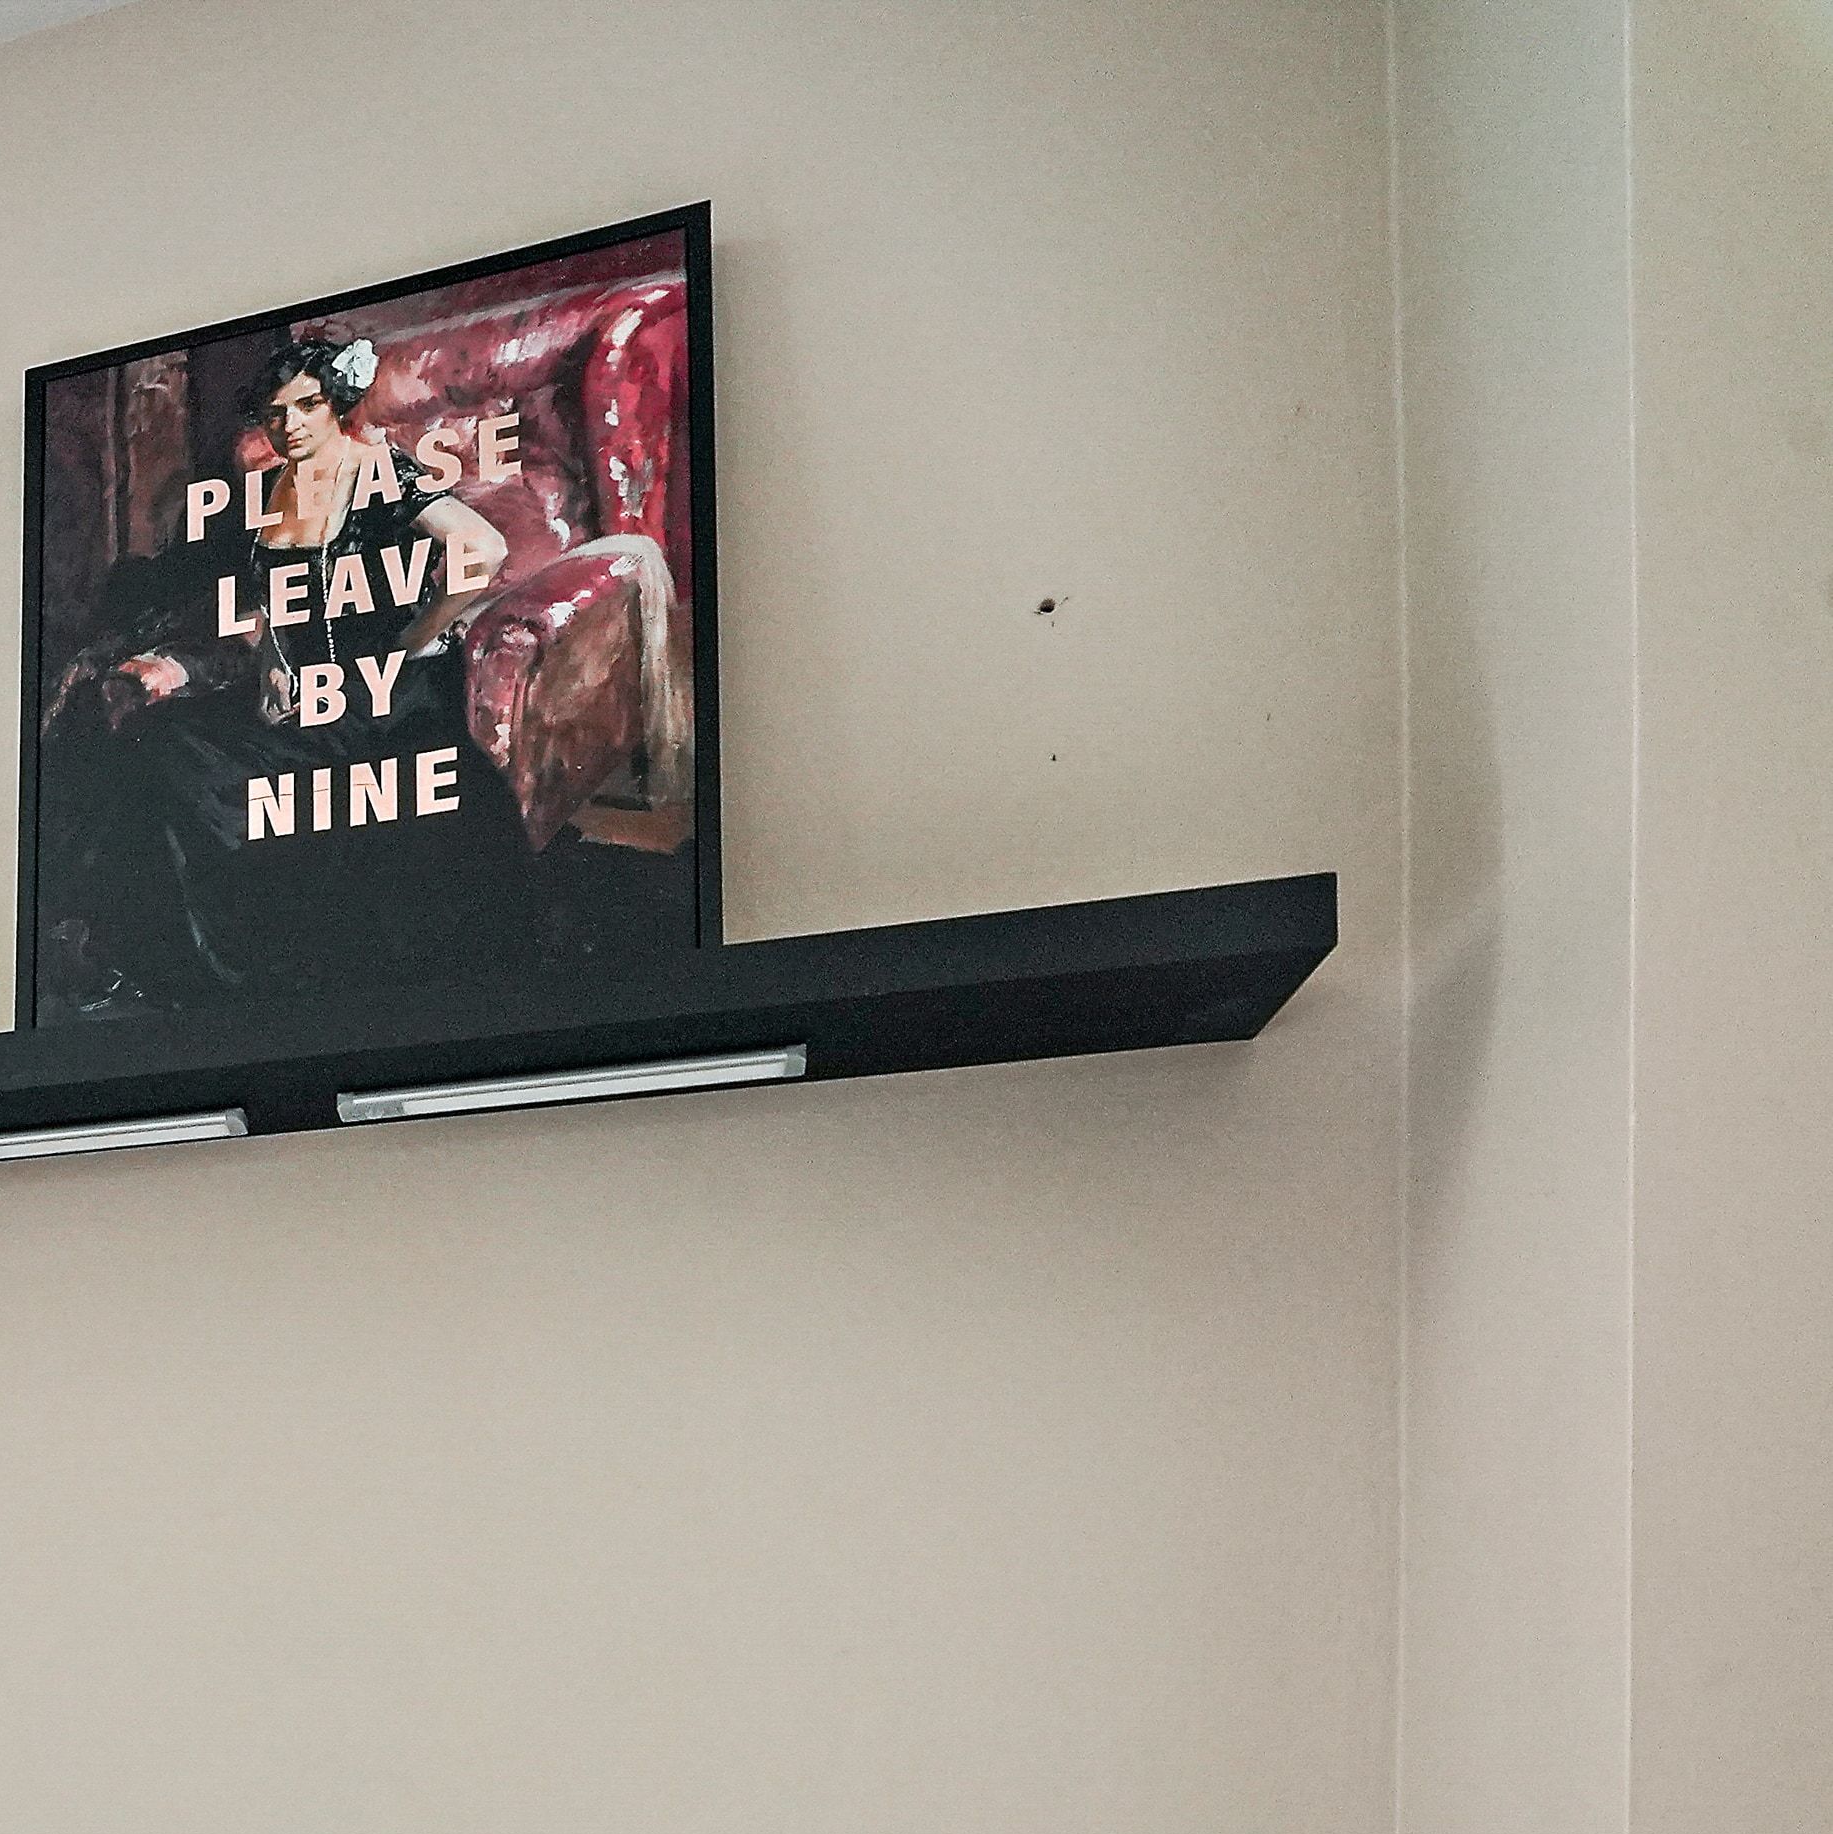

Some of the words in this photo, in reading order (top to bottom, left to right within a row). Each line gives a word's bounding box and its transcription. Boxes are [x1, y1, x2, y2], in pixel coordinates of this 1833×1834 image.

[186, 412, 523, 543] PLEASE
[217, 532, 491, 638] LEAVE
[299, 649, 409, 728] BY
[247, 746, 461, 841] NINE
